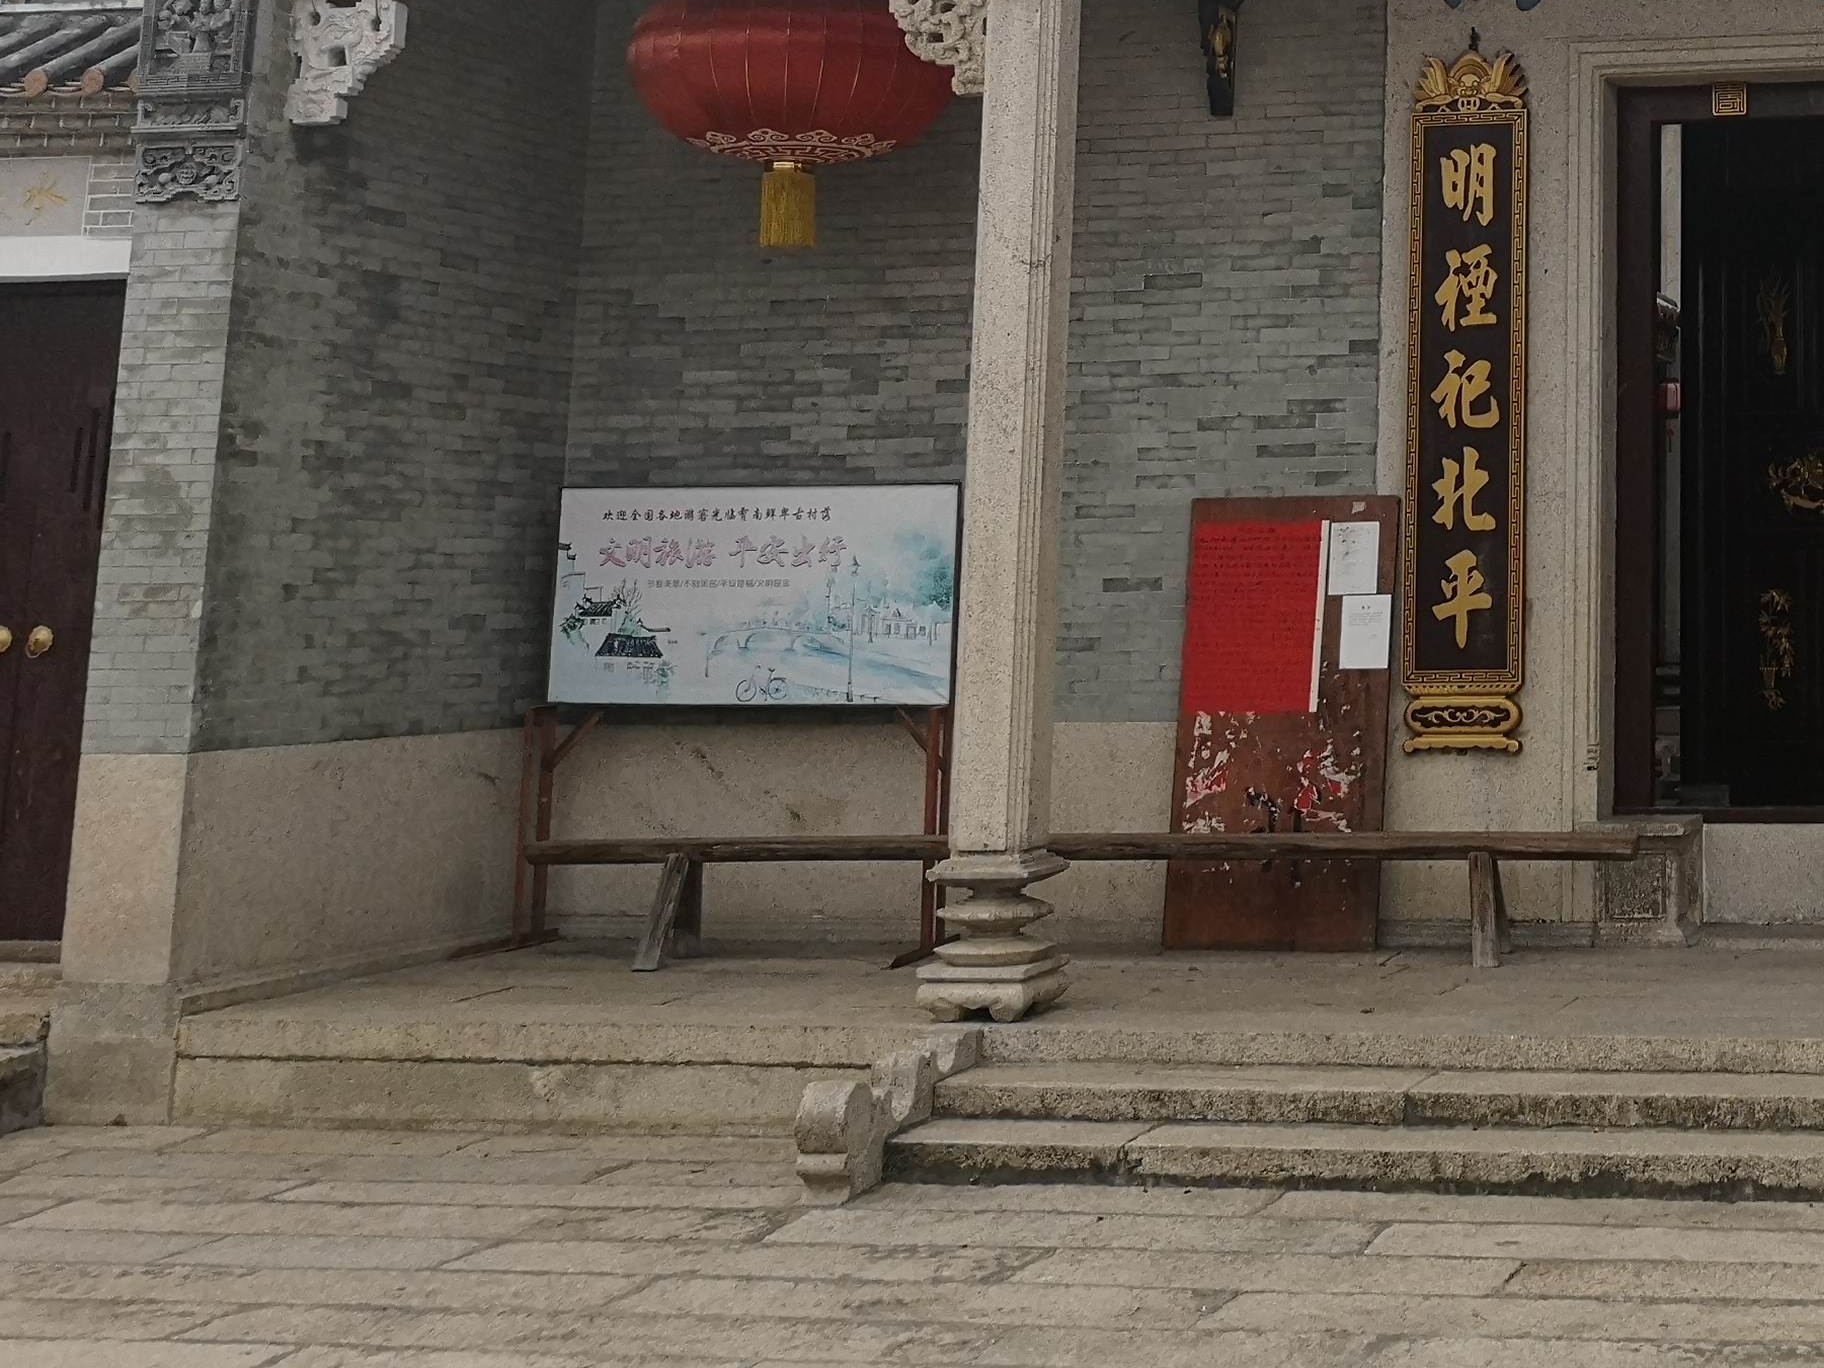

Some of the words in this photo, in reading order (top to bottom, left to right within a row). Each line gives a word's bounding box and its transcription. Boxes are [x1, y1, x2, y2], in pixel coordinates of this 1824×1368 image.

[599, 535, 716, 568] 文明旅游
[728, 535, 848, 568] 平安出行
